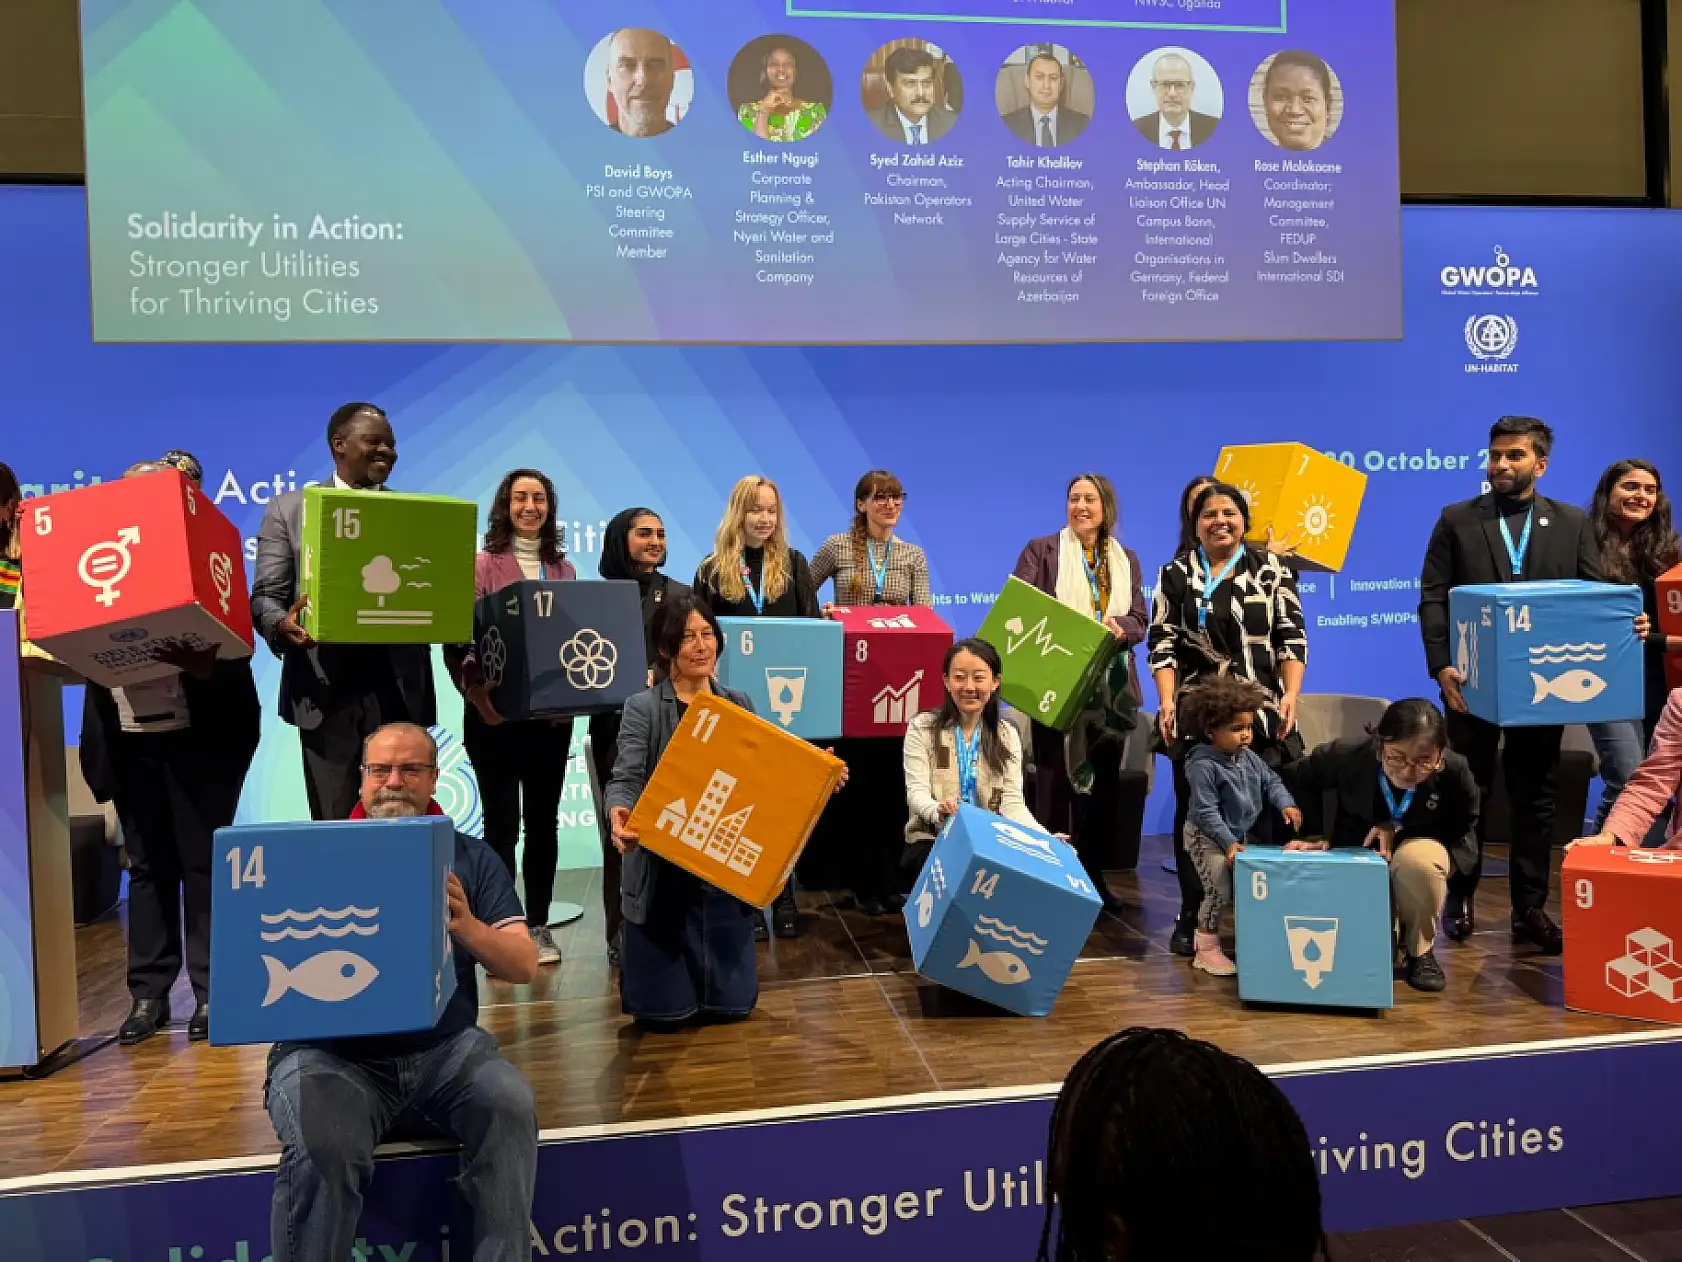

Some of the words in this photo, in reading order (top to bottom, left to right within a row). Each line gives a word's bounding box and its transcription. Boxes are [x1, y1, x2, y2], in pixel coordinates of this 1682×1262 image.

[743, 151, 778, 164] Esther
[782, 152, 819, 167] Ngugi
[870, 154, 898, 169] Syed
[902, 154, 936, 167] Zahid
[938, 155, 964, 167] Aziz
[1006, 156, 1034, 168] Tahir
[1037, 156, 1083, 169] Khalilov
[1137, 158, 1180, 174] Stephan
[1254, 160, 1279, 171] Rose
[605, 165, 640, 178] David
[752, 172, 812, 187] Corporate
[886, 175, 947, 188] Chairman,
[996, 176, 1032, 191] Acting
[1035, 177, 1093, 190] Chairman,
[1125, 179, 1196, 191] Ambassador,
[1199, 180, 1230, 190] Head
[586, 186, 604, 198] PSI
[609, 186, 632, 198] and
[637, 186, 693, 199] GWOPA
[750, 192, 801, 206] Planning
[805, 192, 814, 203] &
[864, 193, 910, 205] Pakistan
[914, 193, 972, 208] Operators
[1008, 195, 1045, 207] United
[1049, 195, 1084, 207] Water
[1130, 197, 1167, 208] Liaison
[1170, 197, 1204, 208] Office
[1207, 198, 1227, 208] UN
[1264, 198, 1334, 211] Management
[616, 206, 665, 221] Steering
[736, 211, 785, 226] Strategy
[788, 211, 830, 225] Officer,
[894, 213, 944, 225] Network
[997, 214, 1036, 228] Supply
[1039, 214, 1080, 225] Service
[1084, 214, 1096, 225] of
[128, 211, 263, 247] Solidarity
[273, 214, 298, 239] in
[308, 214, 404, 240] Action:
[1136, 216, 1182, 229] Campus
[1184, 216, 1215, 228] Bonn,
[609, 225, 674, 238] Committee
[734, 231, 767, 246] Nyeri
[771, 231, 806, 243] Water
[811, 231, 834, 243] and
[1280, 234, 1316, 244] FEDUP
[995, 233, 1027, 247] Large
[1030, 233, 1061, 244] Cities
[1071, 233, 1098, 244] State
[1145, 234, 1213, 245] International
[617, 245, 668, 258] Member
[755, 250, 814, 263] Sanitation
[997, 252, 1040, 267] Agency
[1044, 251, 1058, 264] for
[1061, 252, 1097, 264] Water
[1264, 252, 1289, 263] Slum
[1293, 252, 1337, 264] Dwellers
[1135, 252, 1211, 267] Organisations
[1214, 254, 1224, 264] in
[129, 251, 249, 285] Stronger
[260, 250, 359, 277] Utilities
[756, 270, 814, 285] Company
[1013, 271, 1067, 283] Resources
[1071, 271, 1083, 283] of
[1130, 271, 1185, 286] Germany,
[1188, 271, 1230, 283] Federal
[1257, 271, 1323, 281] International
[1326, 271, 1344, 282] SDI
[1440, 266, 1539, 288] GWOPA
[131, 287, 170, 315] for
[179, 288, 291, 322] Thriving
[302, 289, 379, 314] Cities
[1017, 290, 1079, 304] Azerbaijan
[1142, 290, 1182, 304] Foreign
[1185, 290, 1219, 301] Office
[1464, 363, 1519, 373] UN-HABITAT
[1221, 453, 1233, 472] 7
[1297, 453, 1310, 475] 7
[1363, 448, 1470, 471] October
[1477, 449, 1490, 470] 2
[214, 468, 321, 506] Acti
[186, 486, 197, 516] 5
[34, 506, 52, 536] 5
[332, 507, 361, 540] 15
[1350, 577, 1411, 592] Innovation
[533, 589, 554, 617] 17
[932, 593, 952, 605] hts
[955, 592, 967, 604] to
[1667, 589, 1682, 614] 9
[1317, 614, 1368, 628] Enabling
[1505, 604, 1532, 633] 14
[741, 630, 754, 655] 6
[856, 639, 868, 663] 8
[1039, 689, 1056, 713] 3
[691, 707, 720, 744] 11
[226, 845, 266, 890] 14
[970, 868, 1000, 899] 14
[1251, 871, 1268, 900] 6
[1574, 878, 1593, 909] 9
[721, 1187, 944, 1237] Stronger
[963, 1159, 1058, 1212] Util
[1311, 1131, 1426, 1180] iving
[1445, 1117, 1565, 1162] Cities
